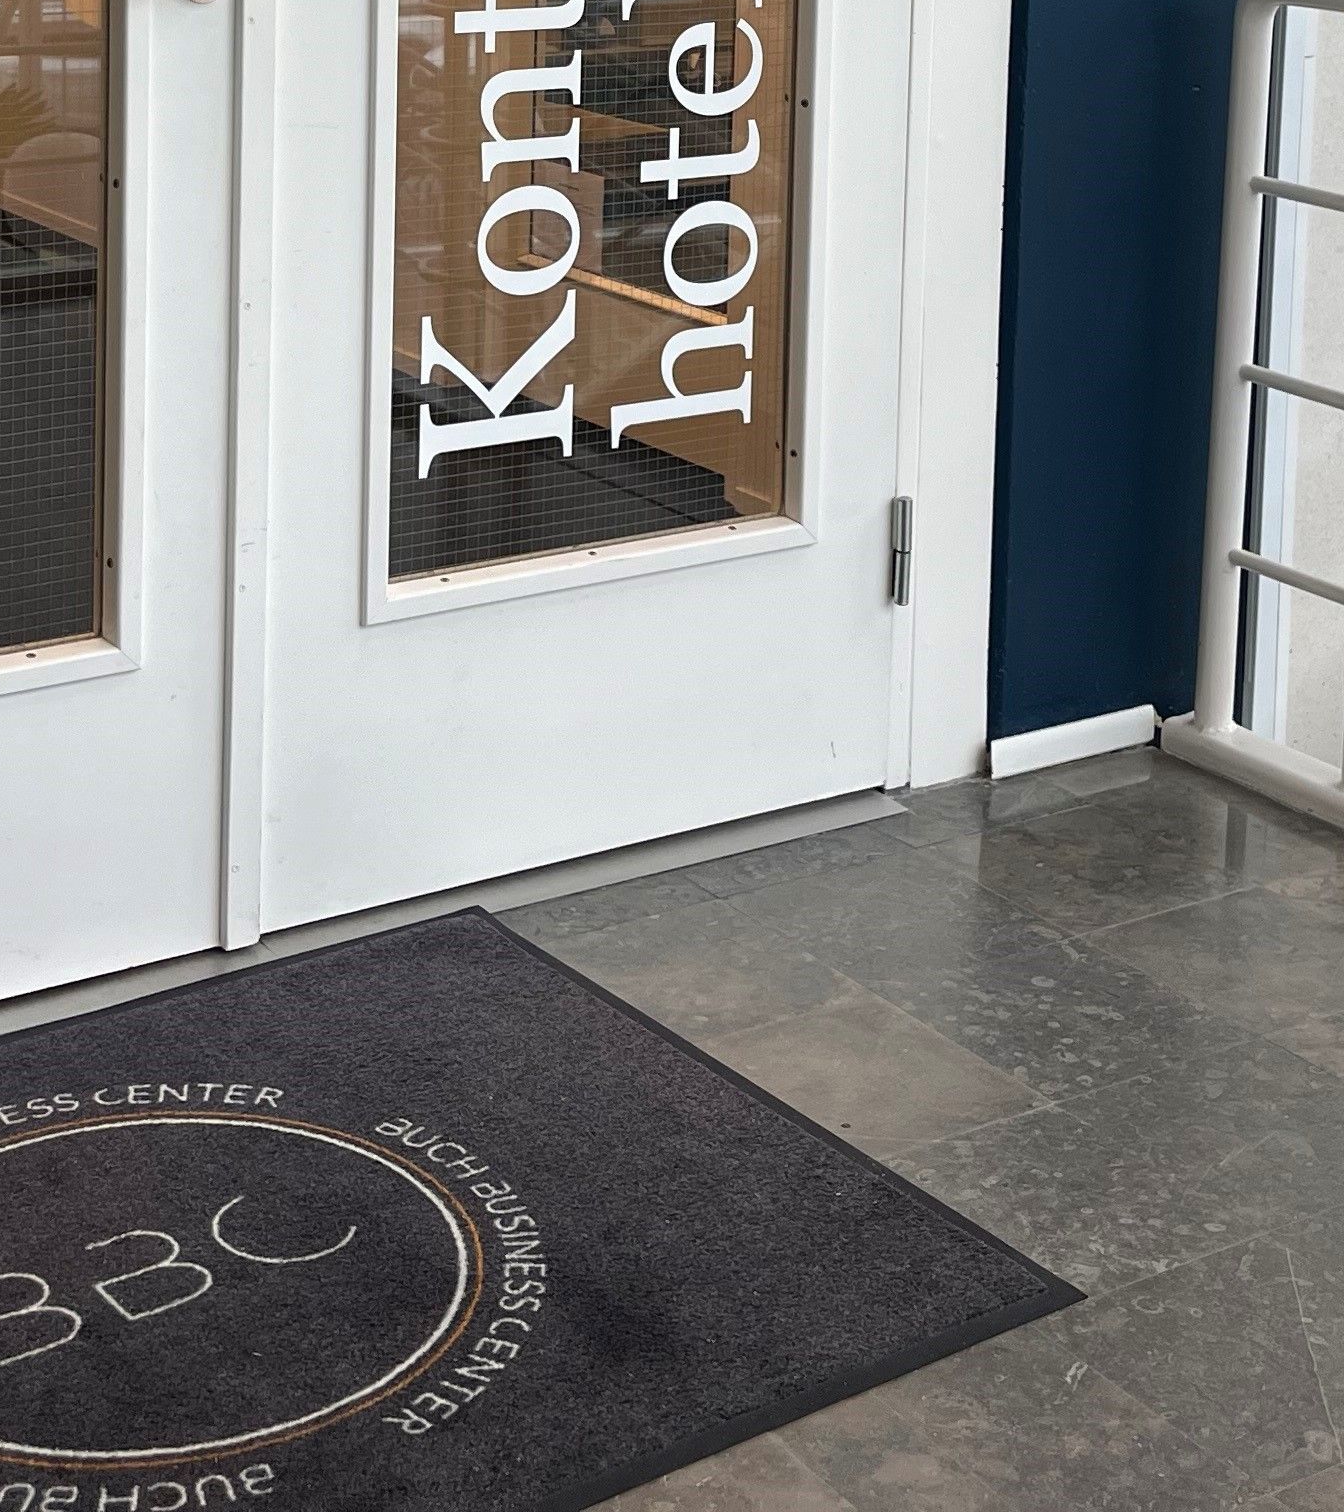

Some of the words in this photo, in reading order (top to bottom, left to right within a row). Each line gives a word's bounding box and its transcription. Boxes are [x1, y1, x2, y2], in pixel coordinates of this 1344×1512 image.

[93, 1082, 285, 1109] CENTER
[374, 1117, 490, 1180] BUCH
[470, 1180, 547, 1312] BUSINESS
[381, 1317, 532, 1435] CENTER
[97, 1463, 275, 1512] BUCH
